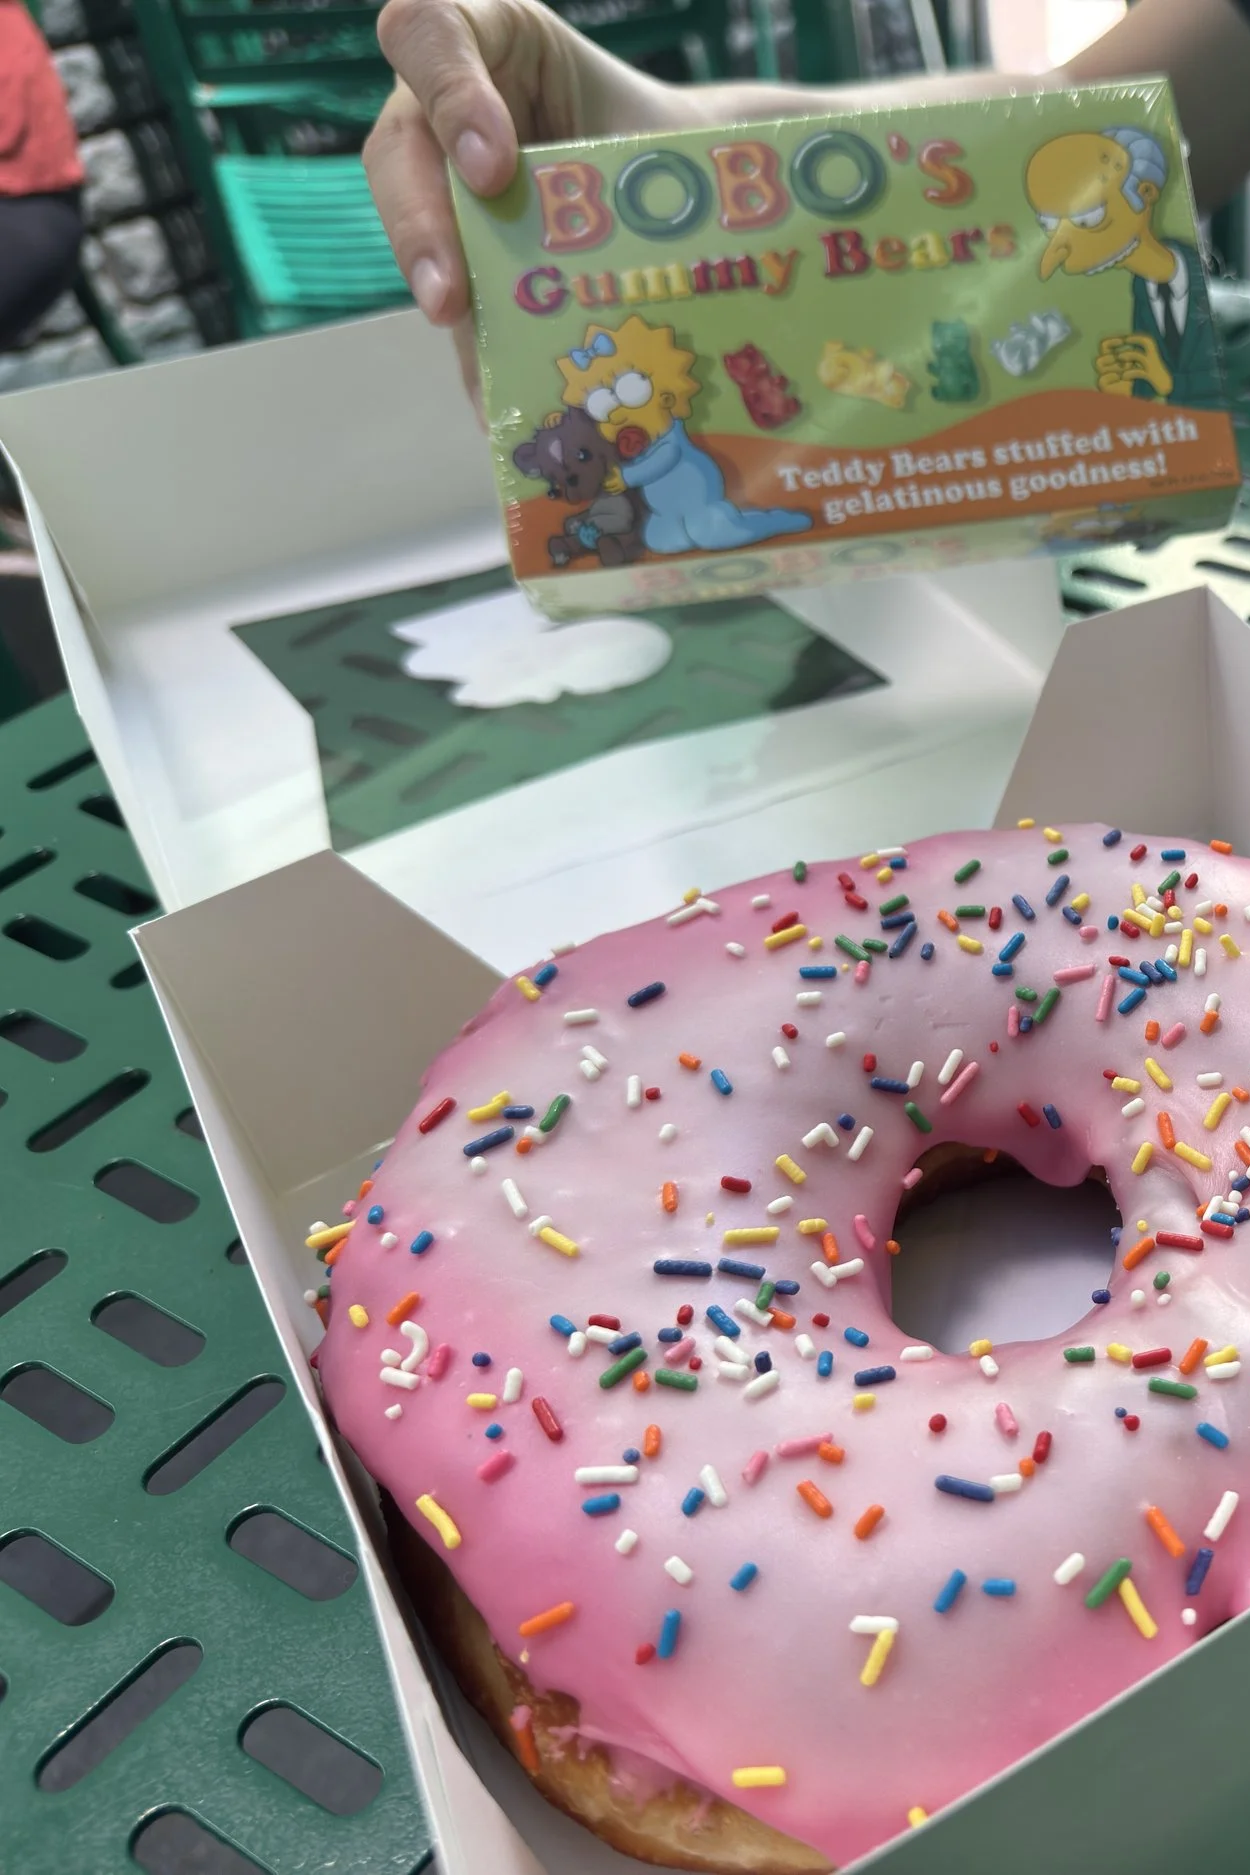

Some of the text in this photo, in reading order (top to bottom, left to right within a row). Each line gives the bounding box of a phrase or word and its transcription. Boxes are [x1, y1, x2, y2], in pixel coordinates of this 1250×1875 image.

[514, 222, 1018, 316] Gummy Bears
[777, 415, 1199, 493] Teddy Bears stuffed with
[822, 453, 1168, 525] gelatinous goodness!
